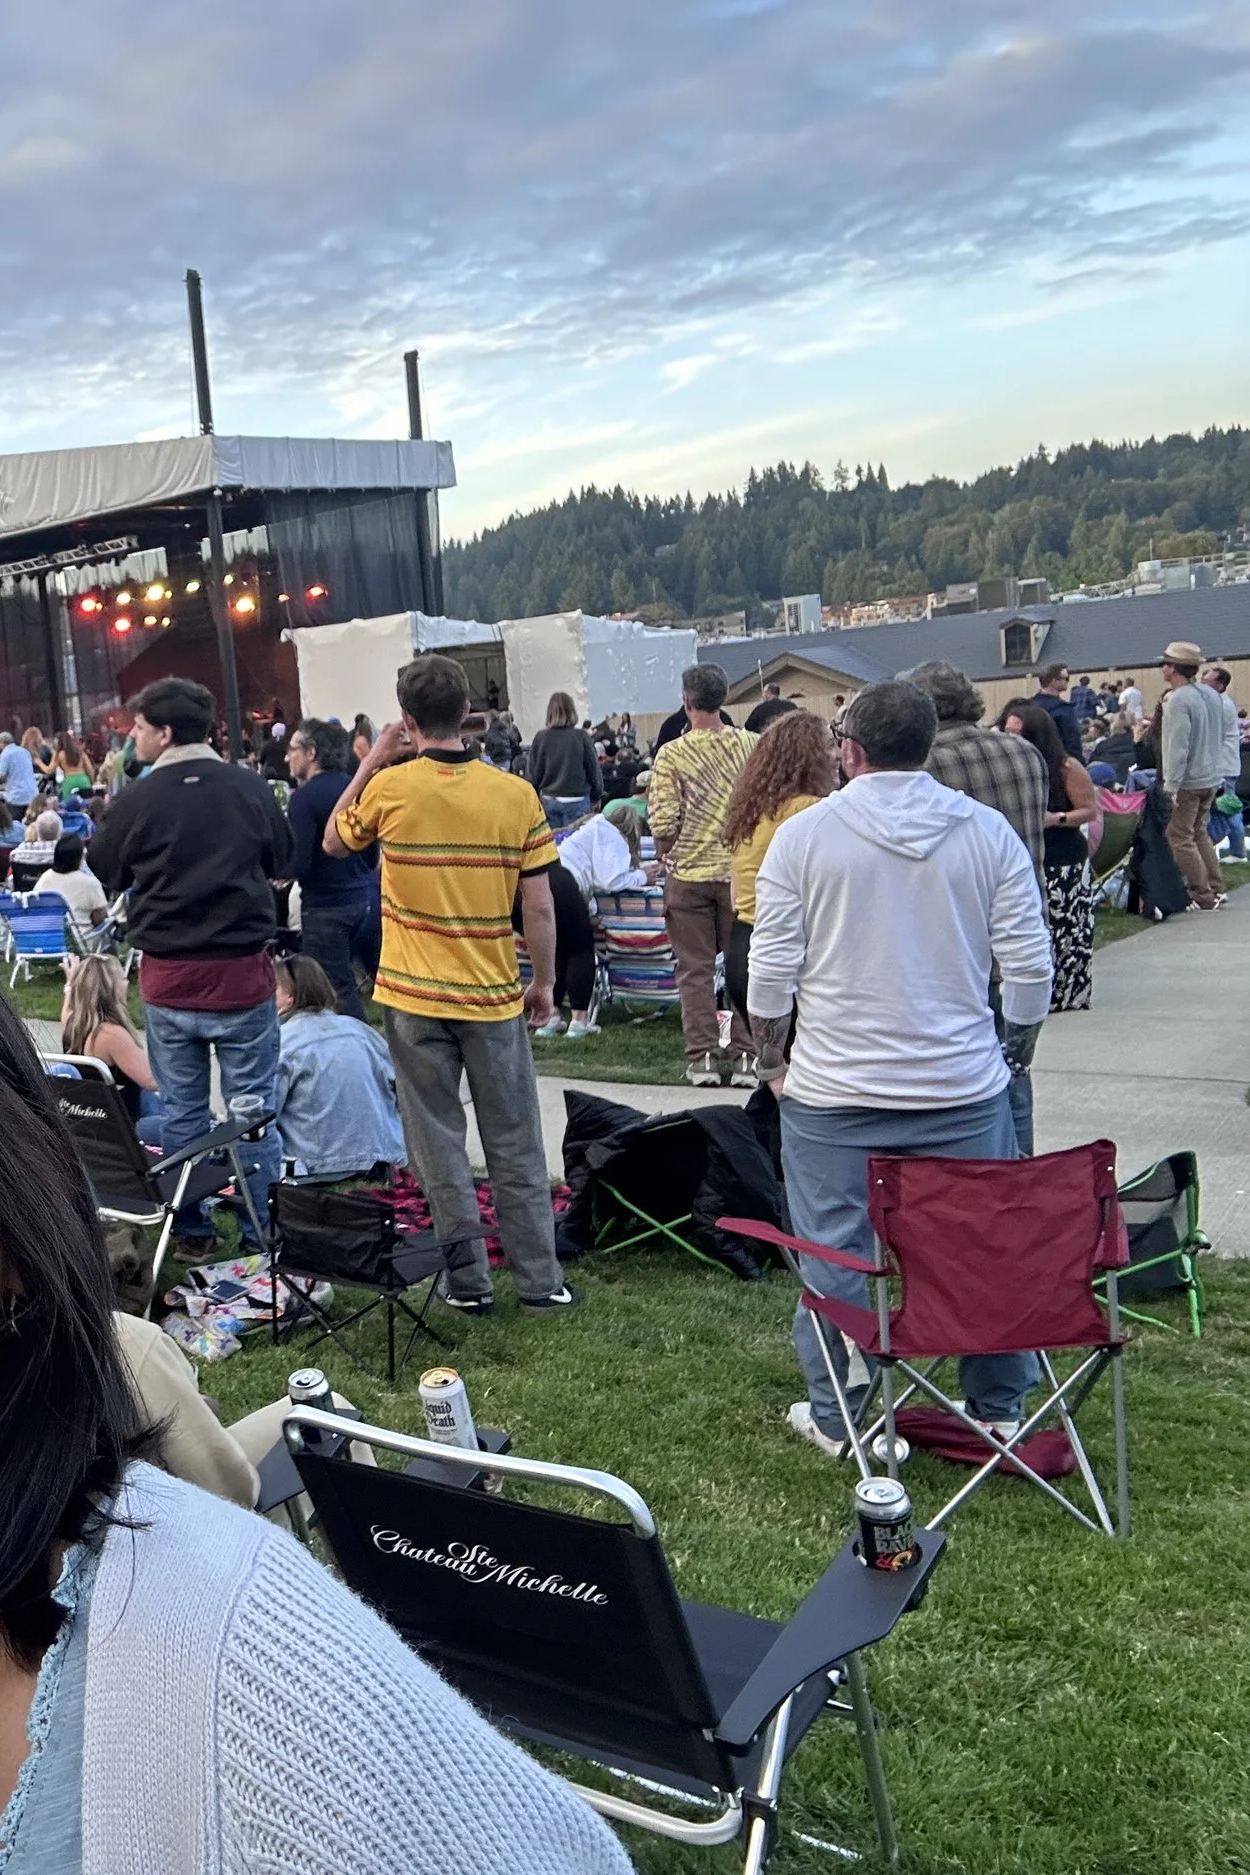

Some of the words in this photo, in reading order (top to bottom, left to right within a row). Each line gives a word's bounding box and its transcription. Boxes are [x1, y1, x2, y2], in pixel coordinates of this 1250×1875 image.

[370, 1524, 478, 1576] Chateau
[447, 1541, 499, 1568] Ste
[459, 1565, 609, 1605] Michelle
